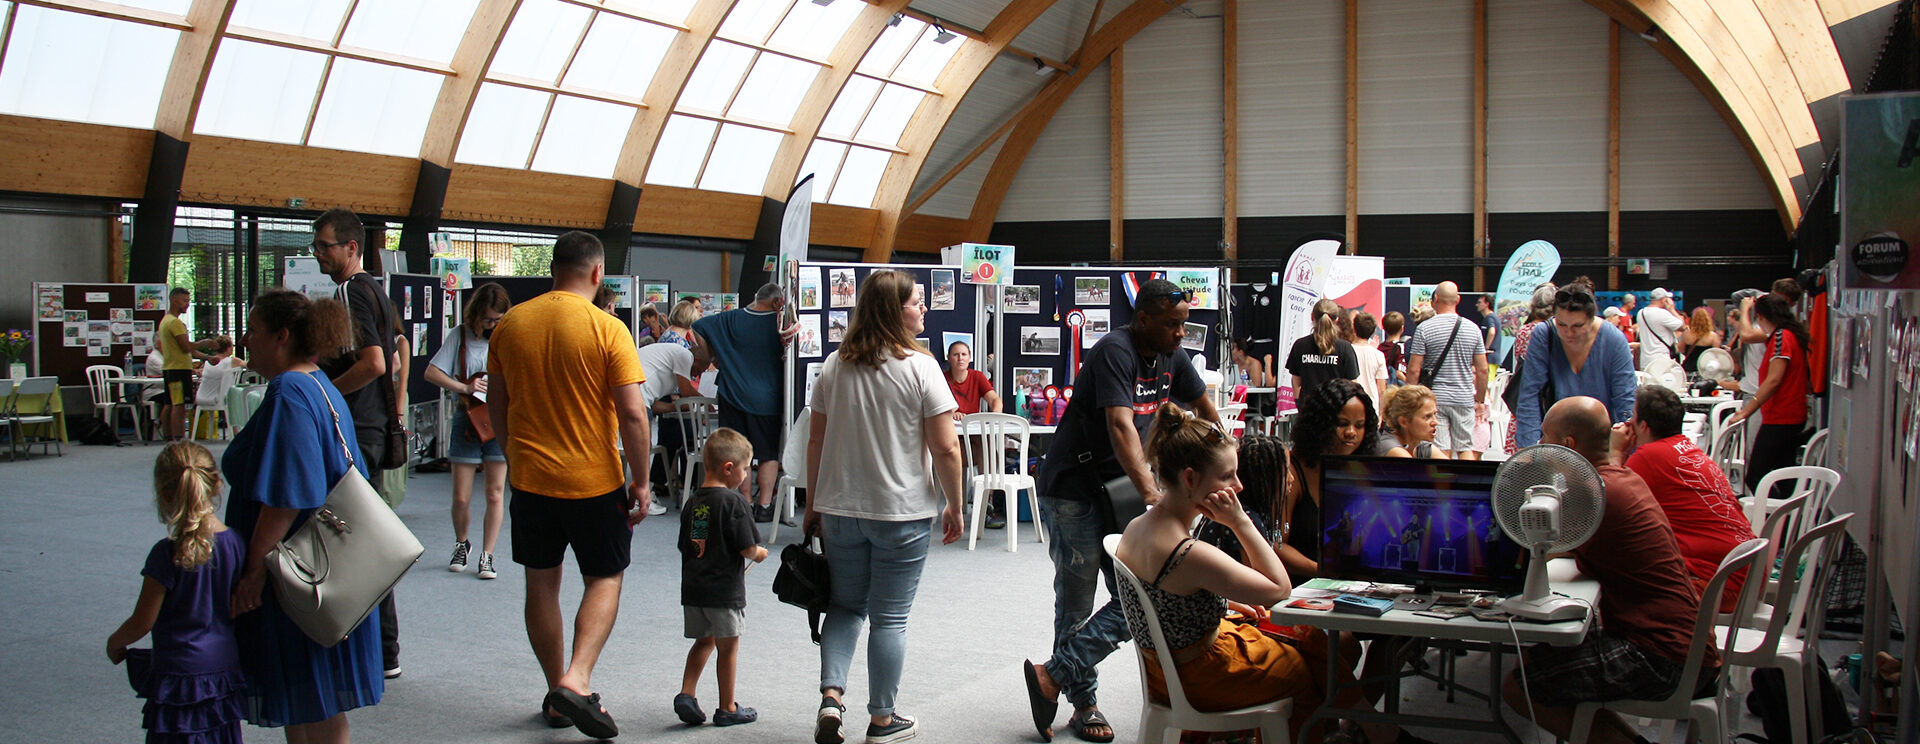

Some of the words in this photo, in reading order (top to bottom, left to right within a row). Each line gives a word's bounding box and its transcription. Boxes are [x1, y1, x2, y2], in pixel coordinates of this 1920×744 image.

[974, 247, 1001, 260] ÎLOT
[1859, 242, 1900, 255] FORUM
[1517, 267, 1544, 277] TRAIL
[1180, 276, 1209, 284] Cheval
[1182, 285, 1212, 293] ttitude
[1301, 354, 1339, 365] CHARLOTTE
